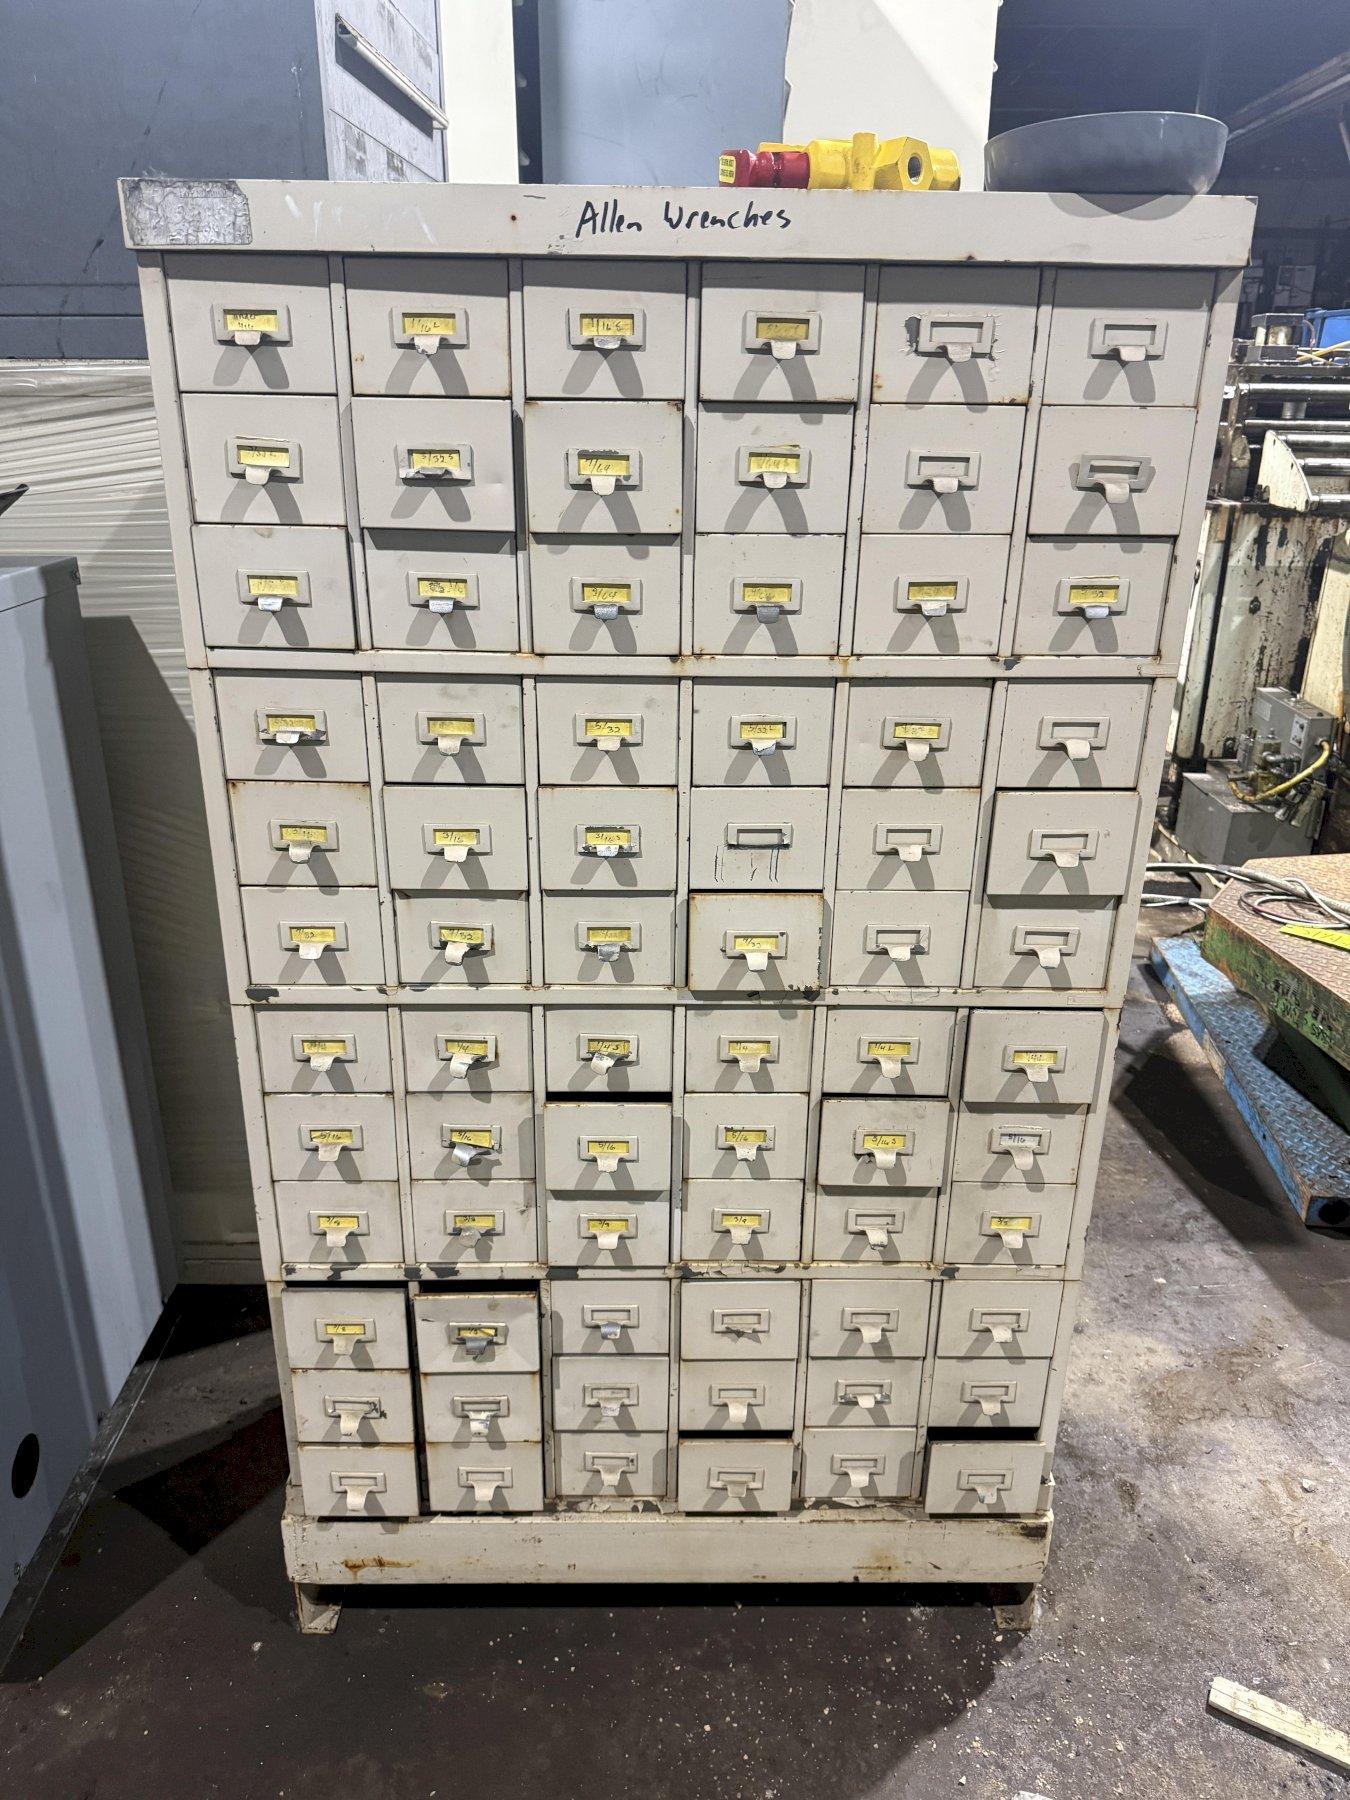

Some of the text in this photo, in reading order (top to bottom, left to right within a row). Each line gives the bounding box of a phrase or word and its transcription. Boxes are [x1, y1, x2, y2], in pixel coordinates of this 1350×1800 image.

[575, 199, 791, 238] Allen Wrenches
[593, 720, 620, 734] 5/32
[442, 831, 463, 844] 3/16
